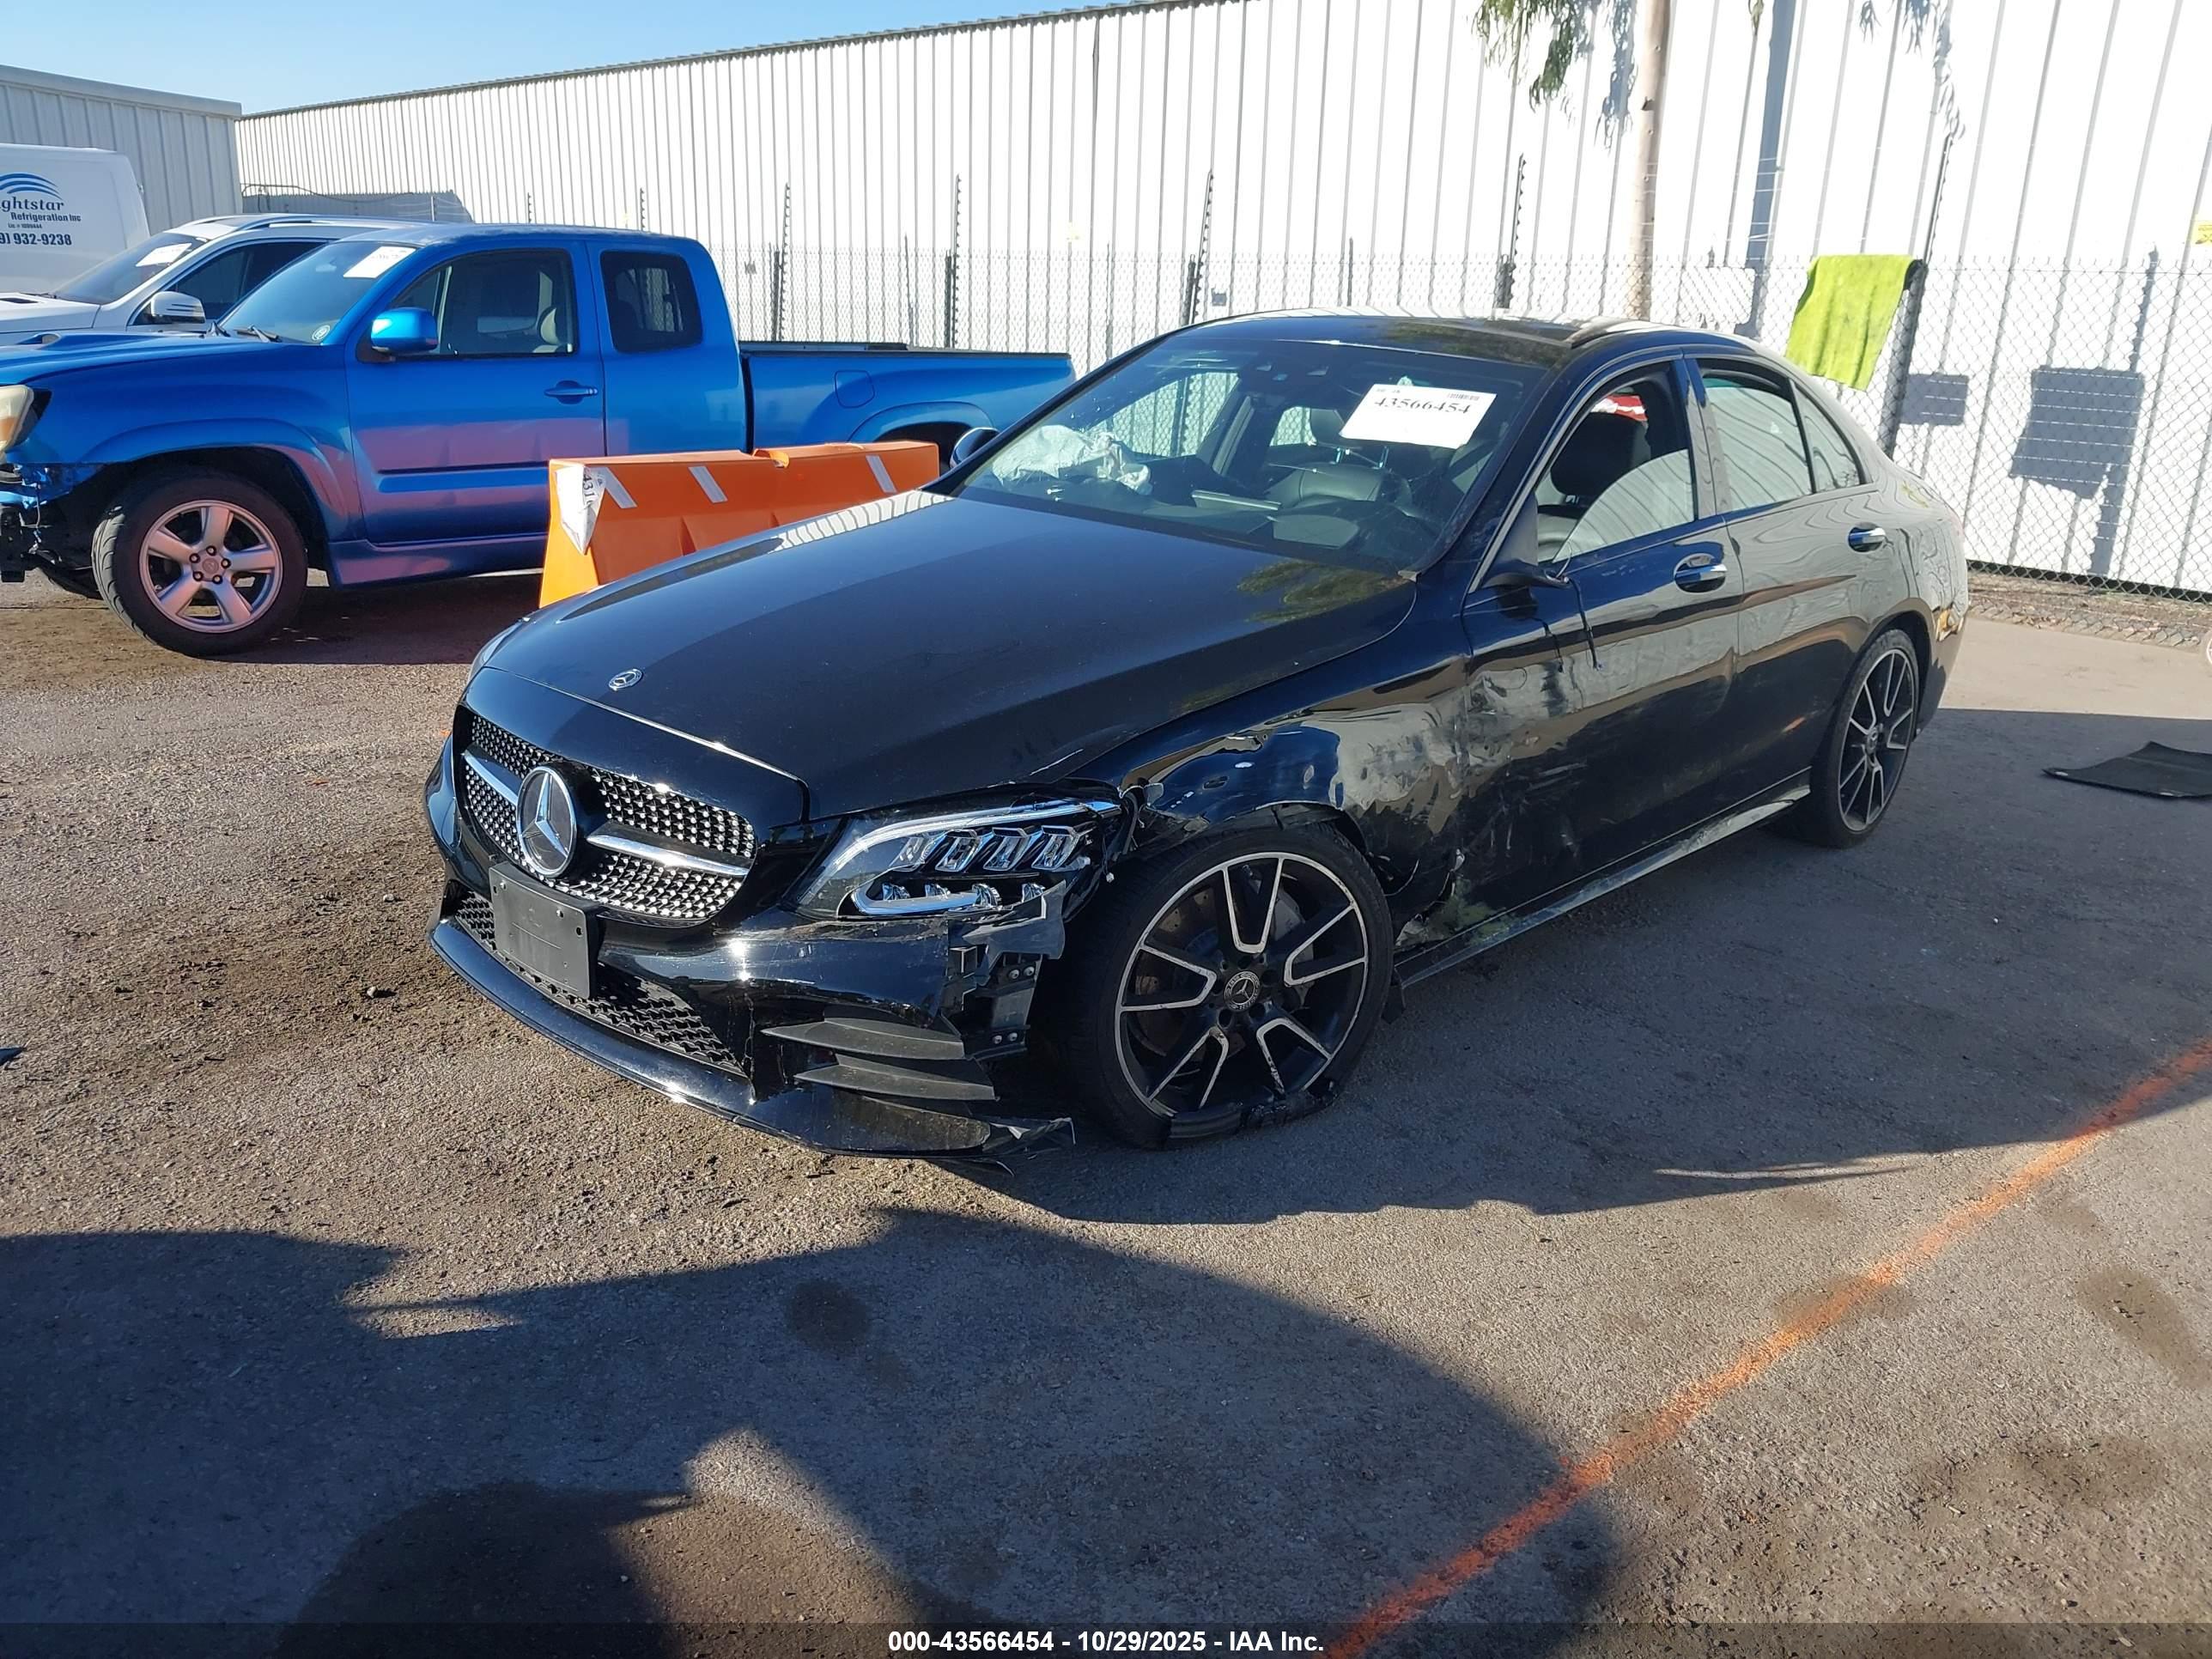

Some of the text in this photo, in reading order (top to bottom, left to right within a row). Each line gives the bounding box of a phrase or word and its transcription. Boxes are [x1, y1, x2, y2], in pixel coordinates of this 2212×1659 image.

[0, 197, 64, 212] ghtstar
[10, 212, 68, 222] Refrigeration
[13, 233, 72, 246] 932-9238
[1375, 398, 1471, 413] 43566454
